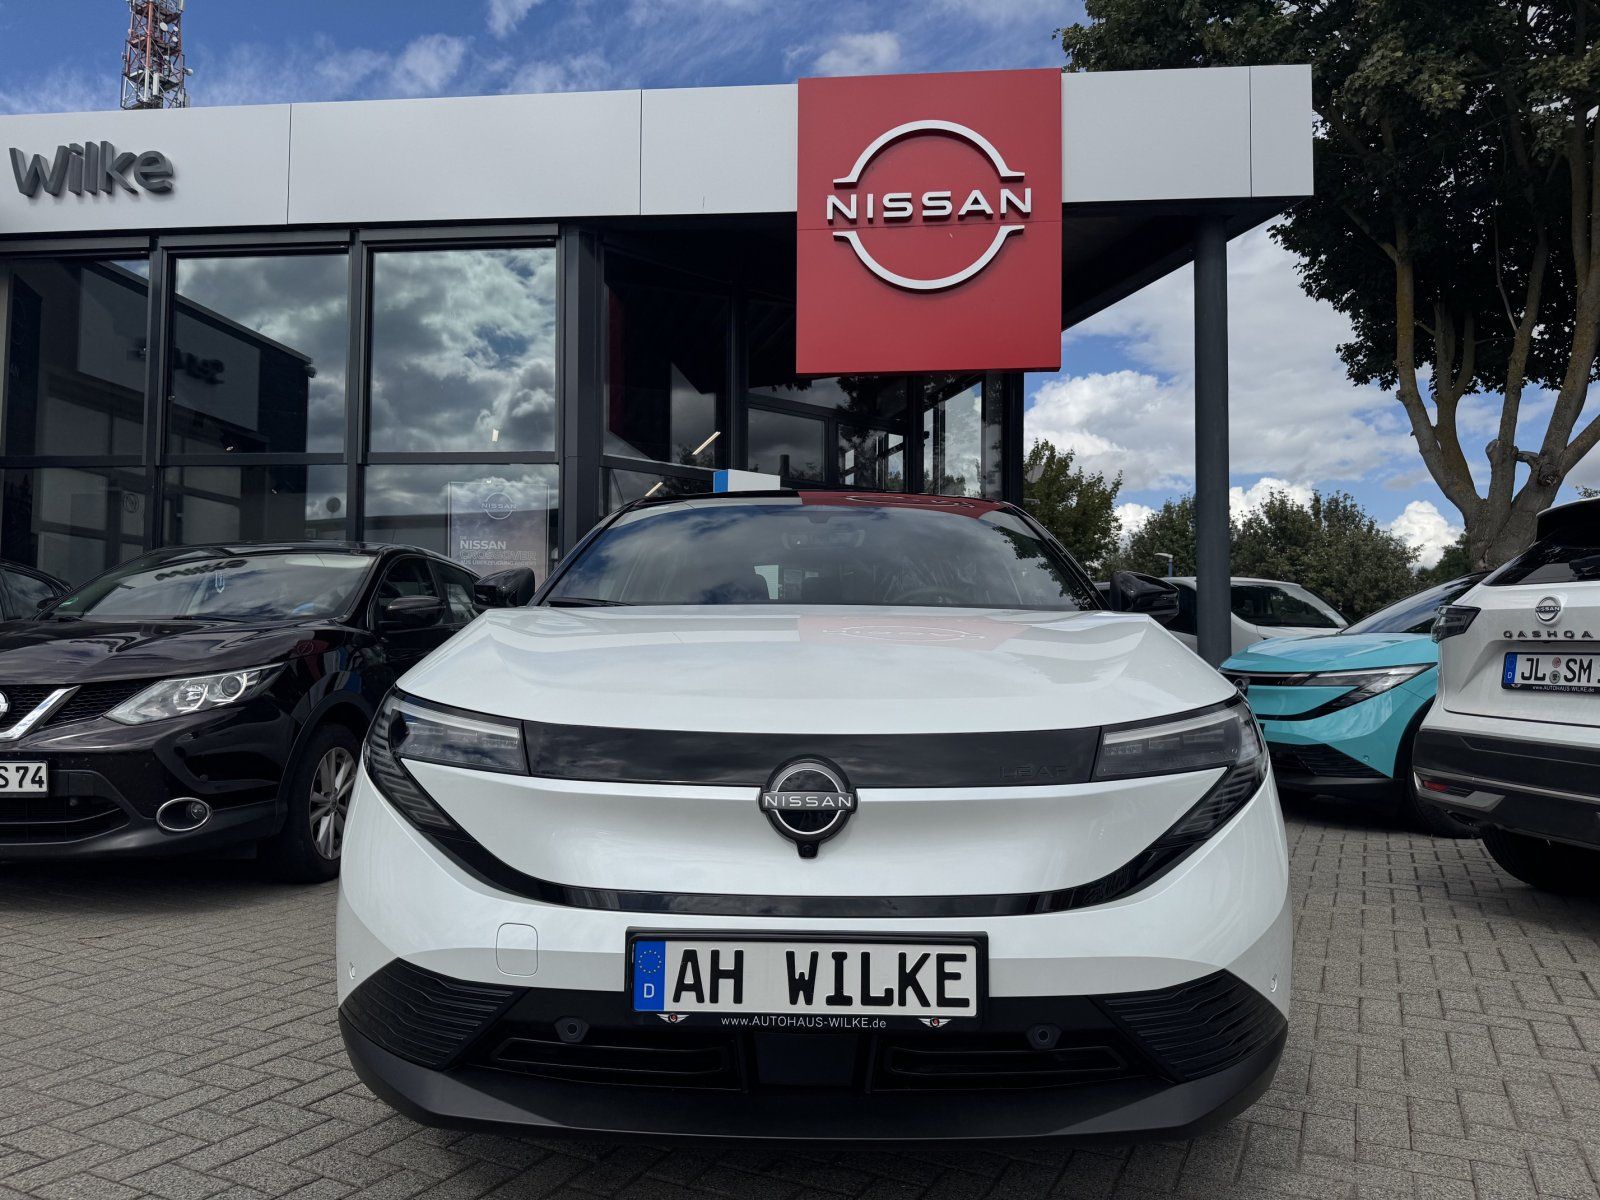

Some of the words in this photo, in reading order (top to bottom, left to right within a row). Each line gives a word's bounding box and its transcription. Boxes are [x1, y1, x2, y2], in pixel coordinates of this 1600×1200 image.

[9, 140, 174, 198] Wilke
[826, 187, 1032, 224] NISSAN
[460, 540, 506, 550] NISSAN
[1503, 631, 1593, 639] QASHQA
[1507, 671, 1513, 679] D
[1521, 658, 1546, 681] JL
[1563, 658, 1593, 682] SM
[15, 766, 44, 788] 74
[1002, 765, 1067, 778] LEAF
[765, 795, 852, 807] NISSAN
[672, 949, 744, 1004] AH
[785, 950, 970, 1008] WILKE
[643, 983, 655, 999] D
[721, 1015, 887, 1029] www.AUTOHAUS-WILKE.de
